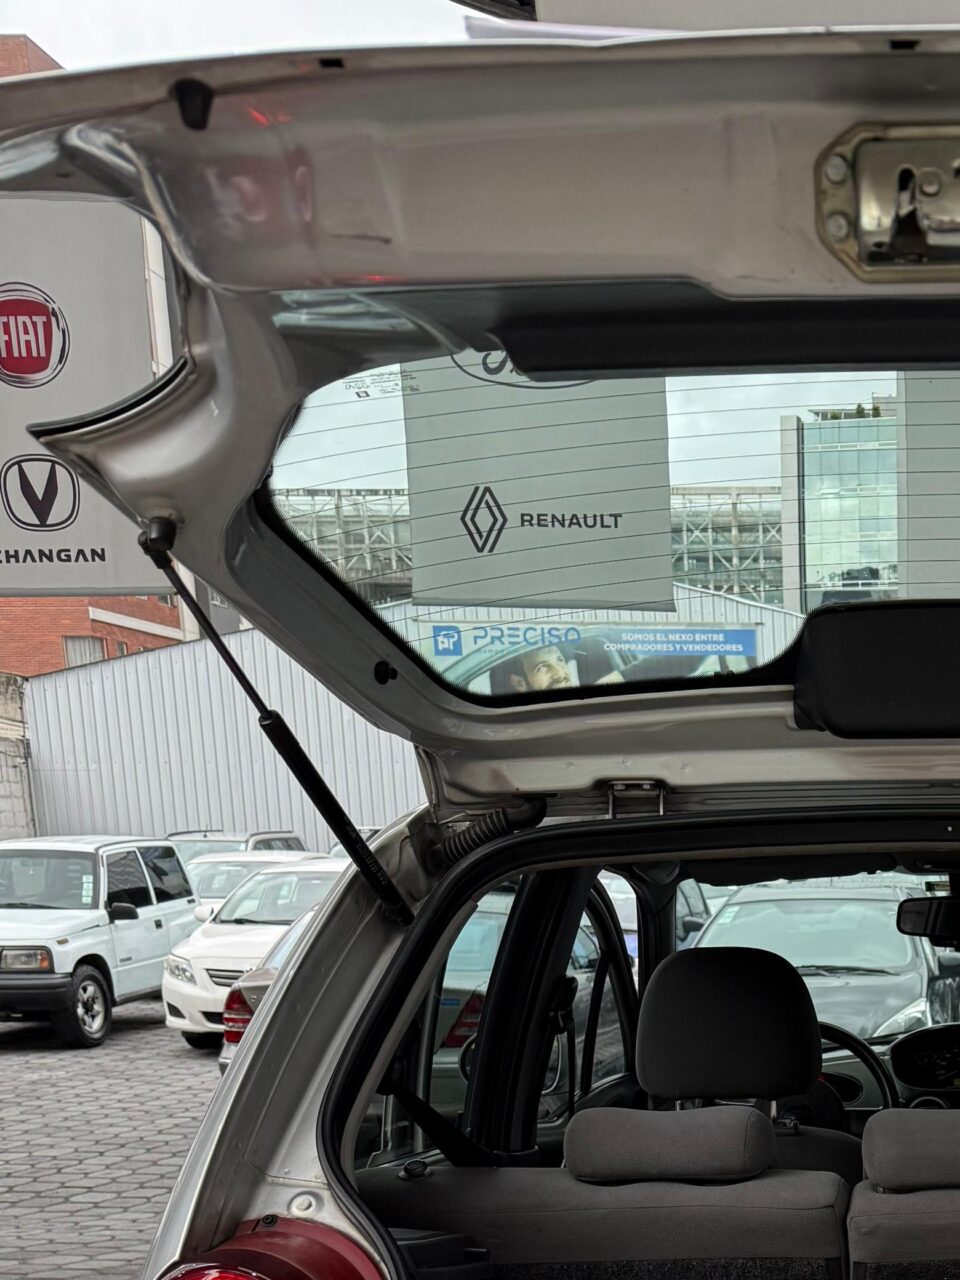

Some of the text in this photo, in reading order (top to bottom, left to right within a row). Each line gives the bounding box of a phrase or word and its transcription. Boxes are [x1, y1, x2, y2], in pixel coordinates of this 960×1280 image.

[0, 315, 47, 358] FIAT
[520, 512, 623, 529] RENAULT
[0, 547, 106, 564] HANGAN
[473, 626, 581, 646] PRECISO
[621, 633, 725, 642] SOMOS EL NEXO ENTRE
[603, 643, 674, 652] COMPRADORES
[682, 643, 744, 652] VENDEDORES
